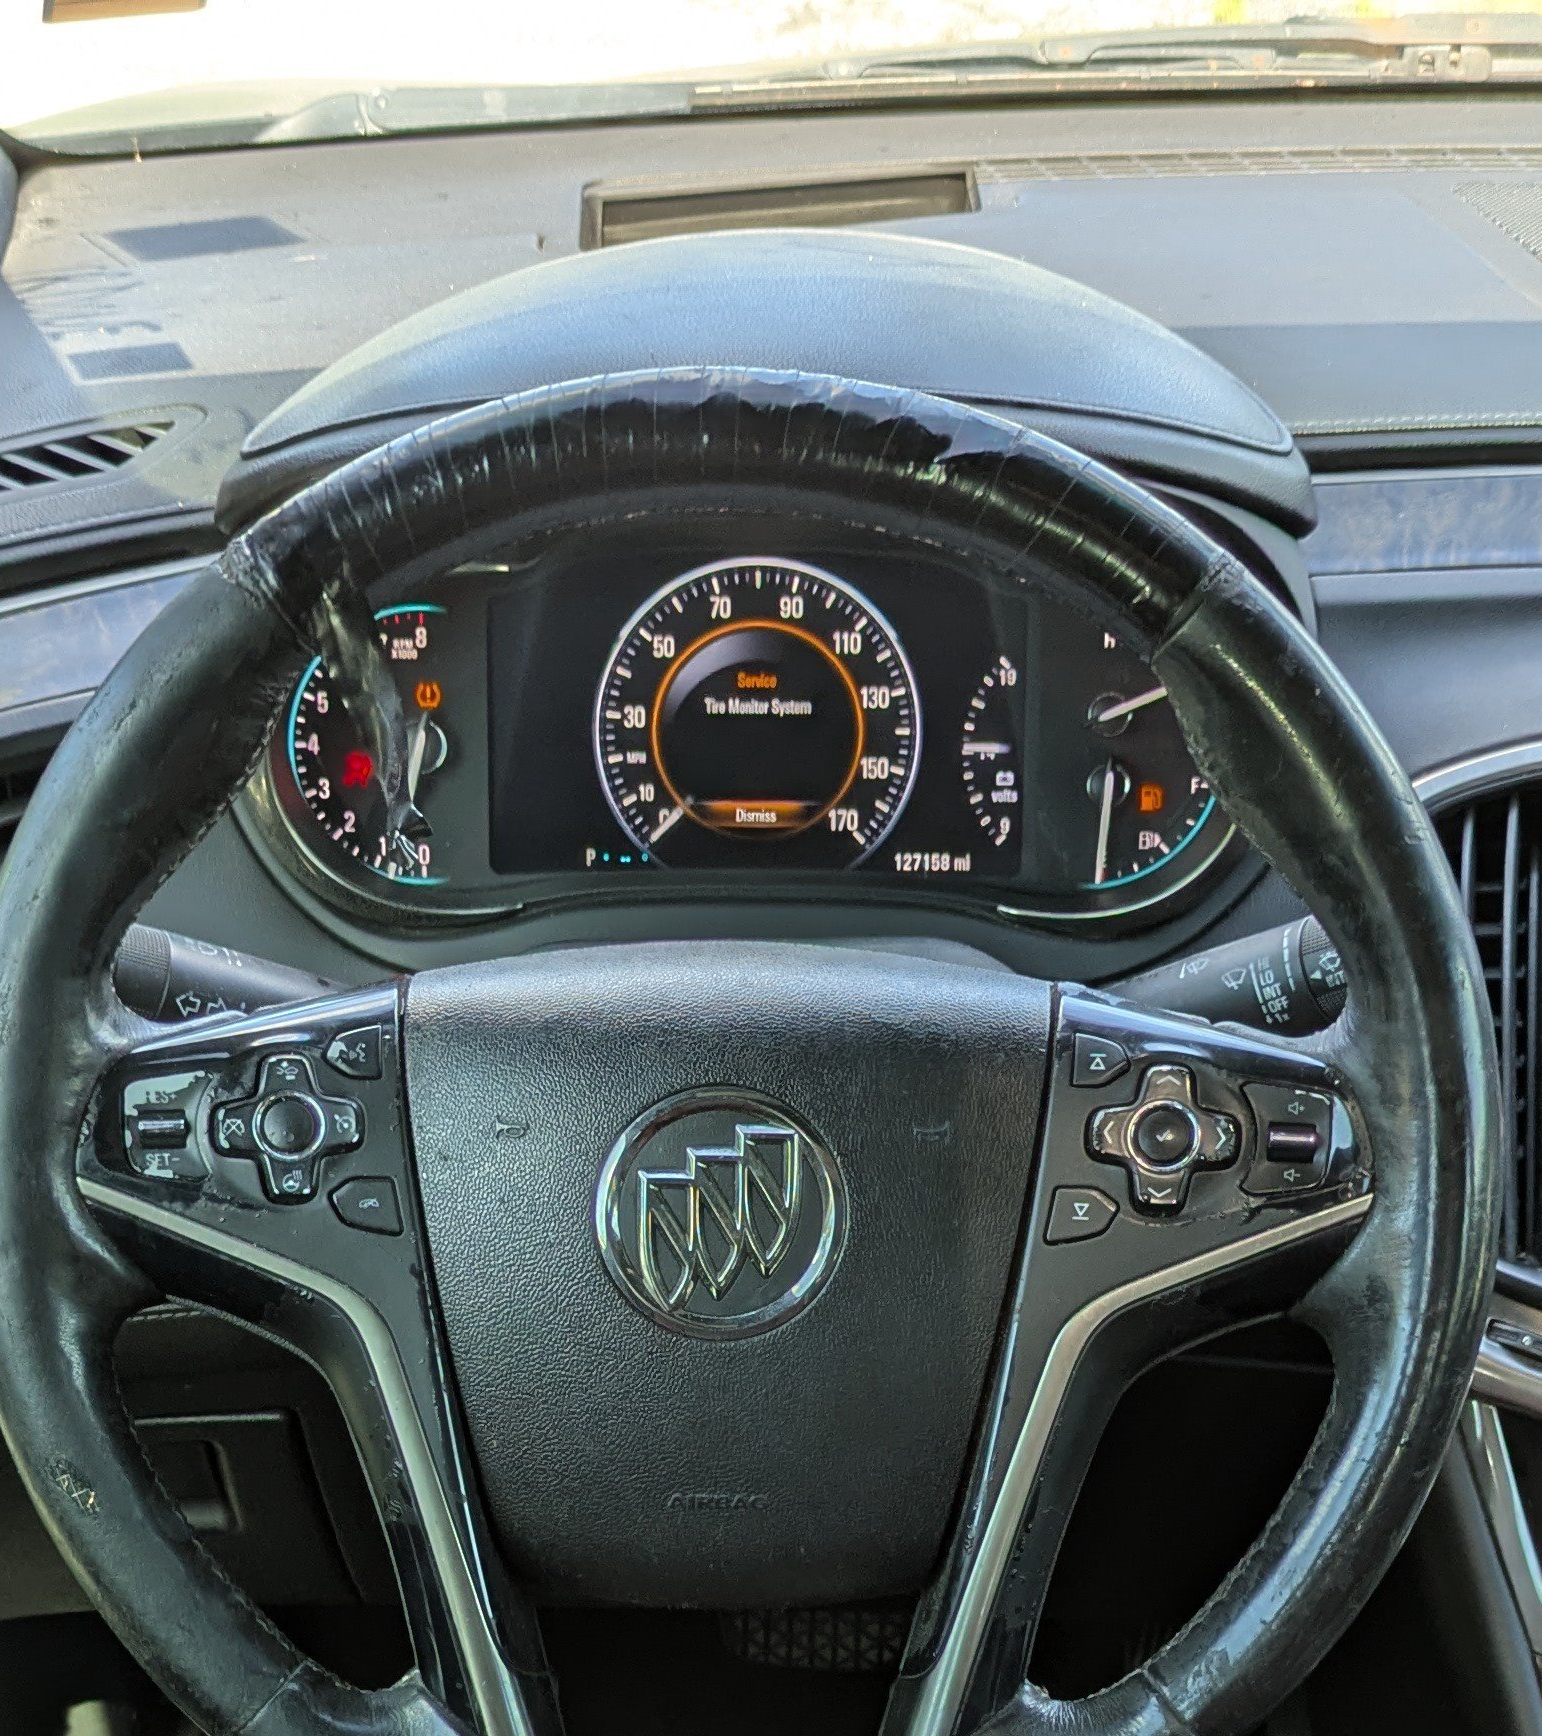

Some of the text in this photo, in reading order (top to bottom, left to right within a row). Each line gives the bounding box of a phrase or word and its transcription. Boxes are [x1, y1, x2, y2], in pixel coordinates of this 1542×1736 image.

[710, 596, 731, 619] 70
[780, 596, 804, 619] 90
[415, 626, 427, 648] 8
[653, 635, 675, 659] 50
[832, 631, 861, 655] 110
[737, 671, 778, 689] Service
[316, 691, 329, 713] 5
[704, 697, 812, 717] Tire Monitor System
[860, 686, 890, 710] 130
[623, 705, 646, 729] 30
[307, 733, 320, 755] 4
[860, 757, 890, 780] 150
[318, 777, 330, 799] 3
[638, 783, 655, 802] 10
[343, 811, 356, 833] 2
[735, 808, 777, 824] Dismiss
[828, 808, 859, 832] 170
[378, 836, 387, 856] 1
[417, 843, 430, 865] 0
[585, 849, 597, 867] P
[894, 852, 951, 873] 127158
